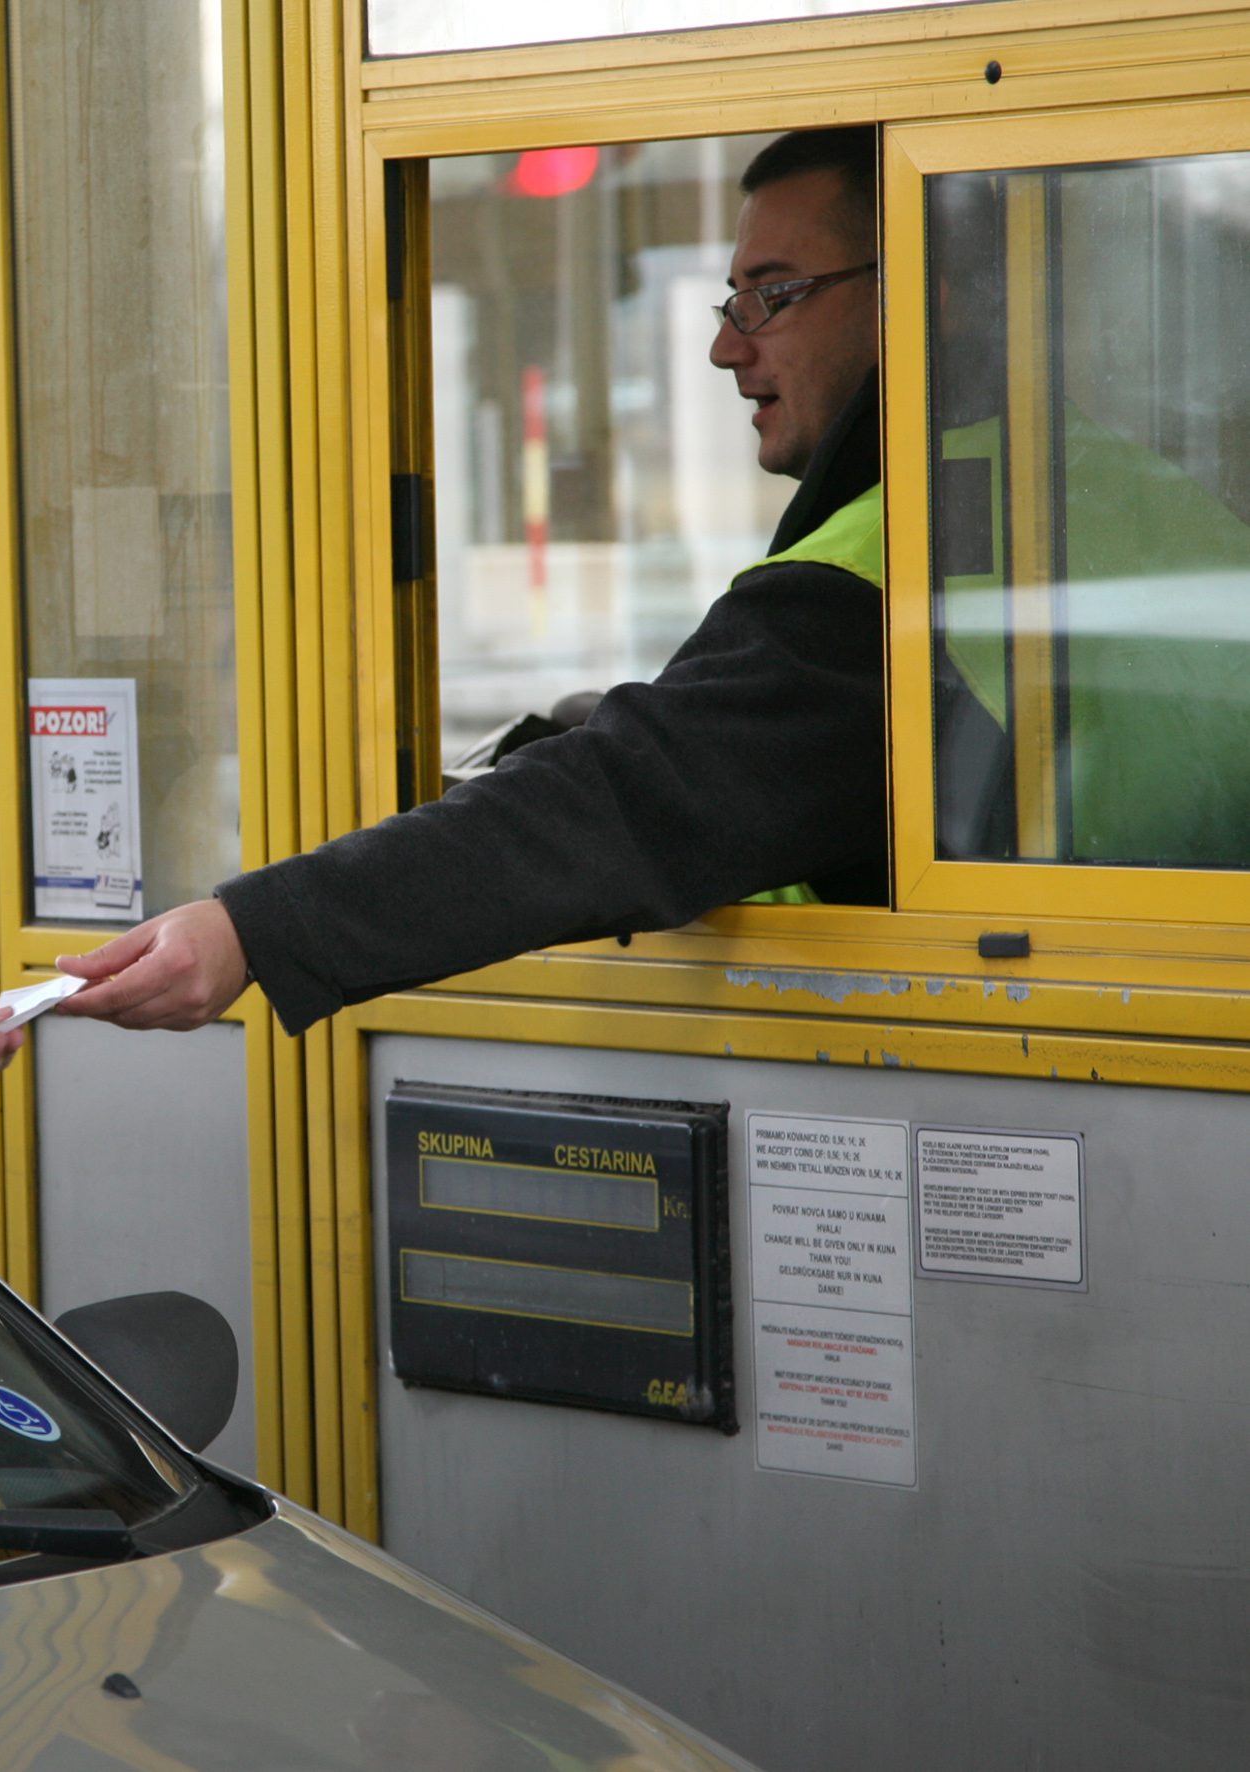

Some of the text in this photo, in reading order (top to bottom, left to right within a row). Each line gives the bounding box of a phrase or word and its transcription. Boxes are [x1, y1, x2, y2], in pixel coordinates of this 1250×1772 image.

[34, 710, 105, 734] POZOR!
[756, 1129, 785, 1140] PRIMAMO
[787, 1131, 817, 1143] KOVANICE
[418, 1131, 656, 1174] SKUPINA CESTARINA
[756, 1144, 765, 1154] WE
[767, 1145, 792, 1156] ACCEPT
[794, 1147, 813, 1158] COINS
[757, 1159, 768, 1169] WIR
[770, 1160, 795, 1172] NEHMEN
[823, 1164, 849, 1176] MÜNZEN
[772, 1204, 885, 1223] POVRAT NOVCA SAMO U KUNAMA
[816, 1223, 841, 1234] HVALA!
[764, 1233, 895, 1255] CHANGE WILL BE GIVEN ONLY IN KUNA
[809, 1252, 851, 1266] THANK YOU!
[779, 1263, 882, 1284] GELDRÜCKGABE NUR IN KUNA
[818, 1284, 843, 1295] DANKE!
